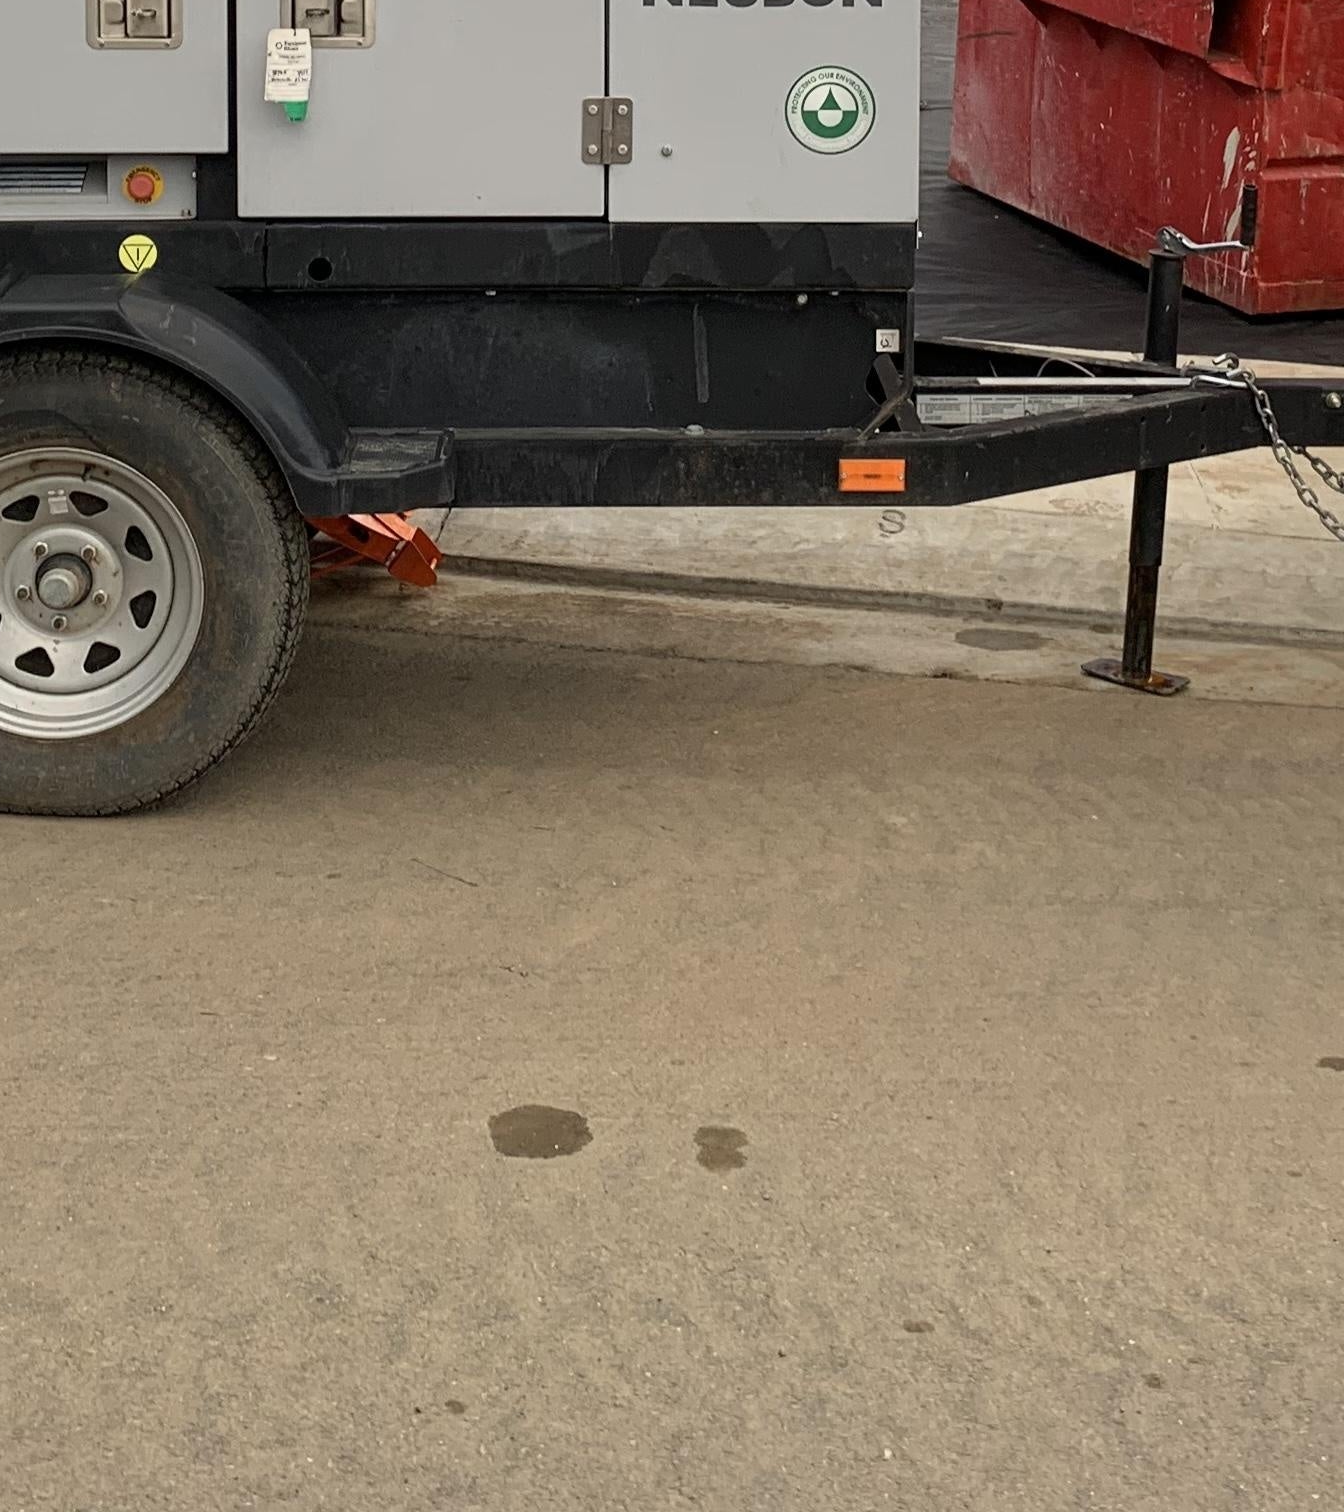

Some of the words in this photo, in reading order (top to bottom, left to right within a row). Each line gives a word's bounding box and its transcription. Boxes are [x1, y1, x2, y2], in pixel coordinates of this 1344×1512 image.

[791, 76, 817, 114] PROTECTING
[818, 72, 834, 80] OUR
[835, 73, 869, 116] ENVIRONMENT
